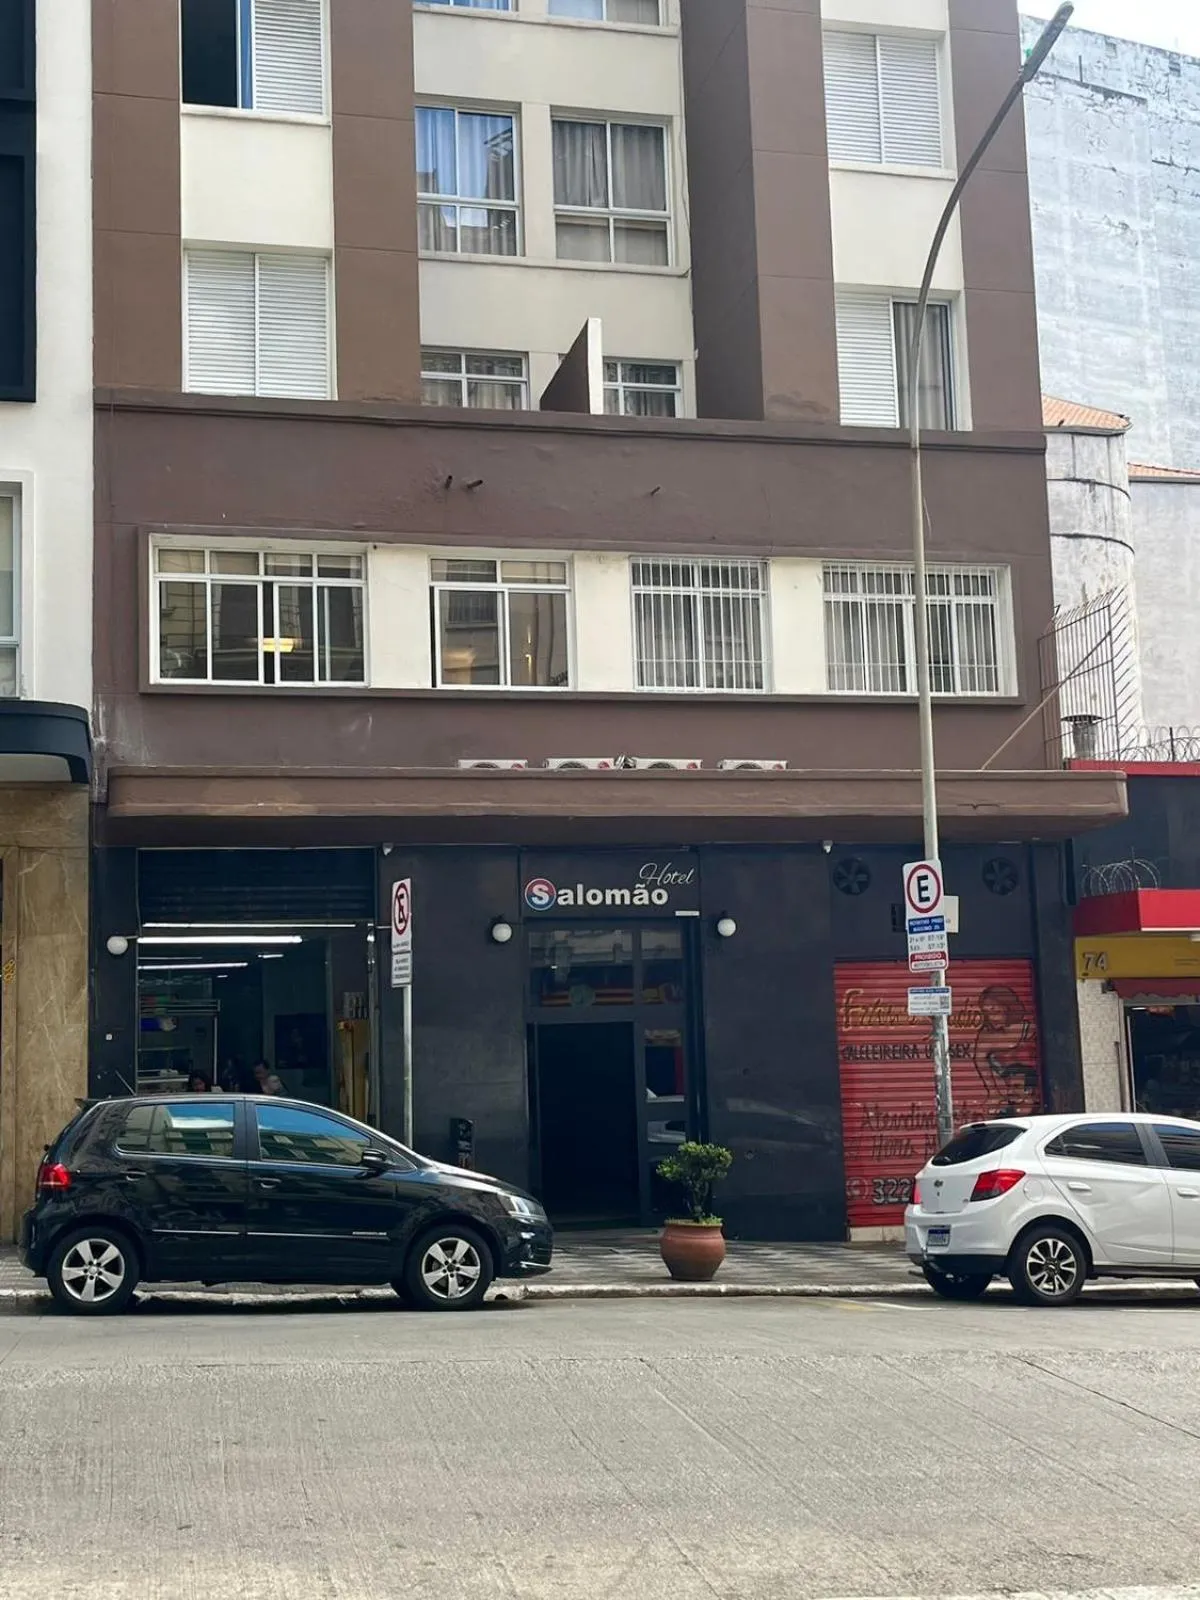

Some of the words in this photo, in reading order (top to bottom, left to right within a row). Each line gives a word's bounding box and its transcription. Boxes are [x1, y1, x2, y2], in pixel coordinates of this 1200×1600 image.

[639, 862, 694, 886] Hotel
[529, 883, 669, 907] Salomão
[917, 874, 931, 903] E
[925, 1042, 972, 1060] USEX
